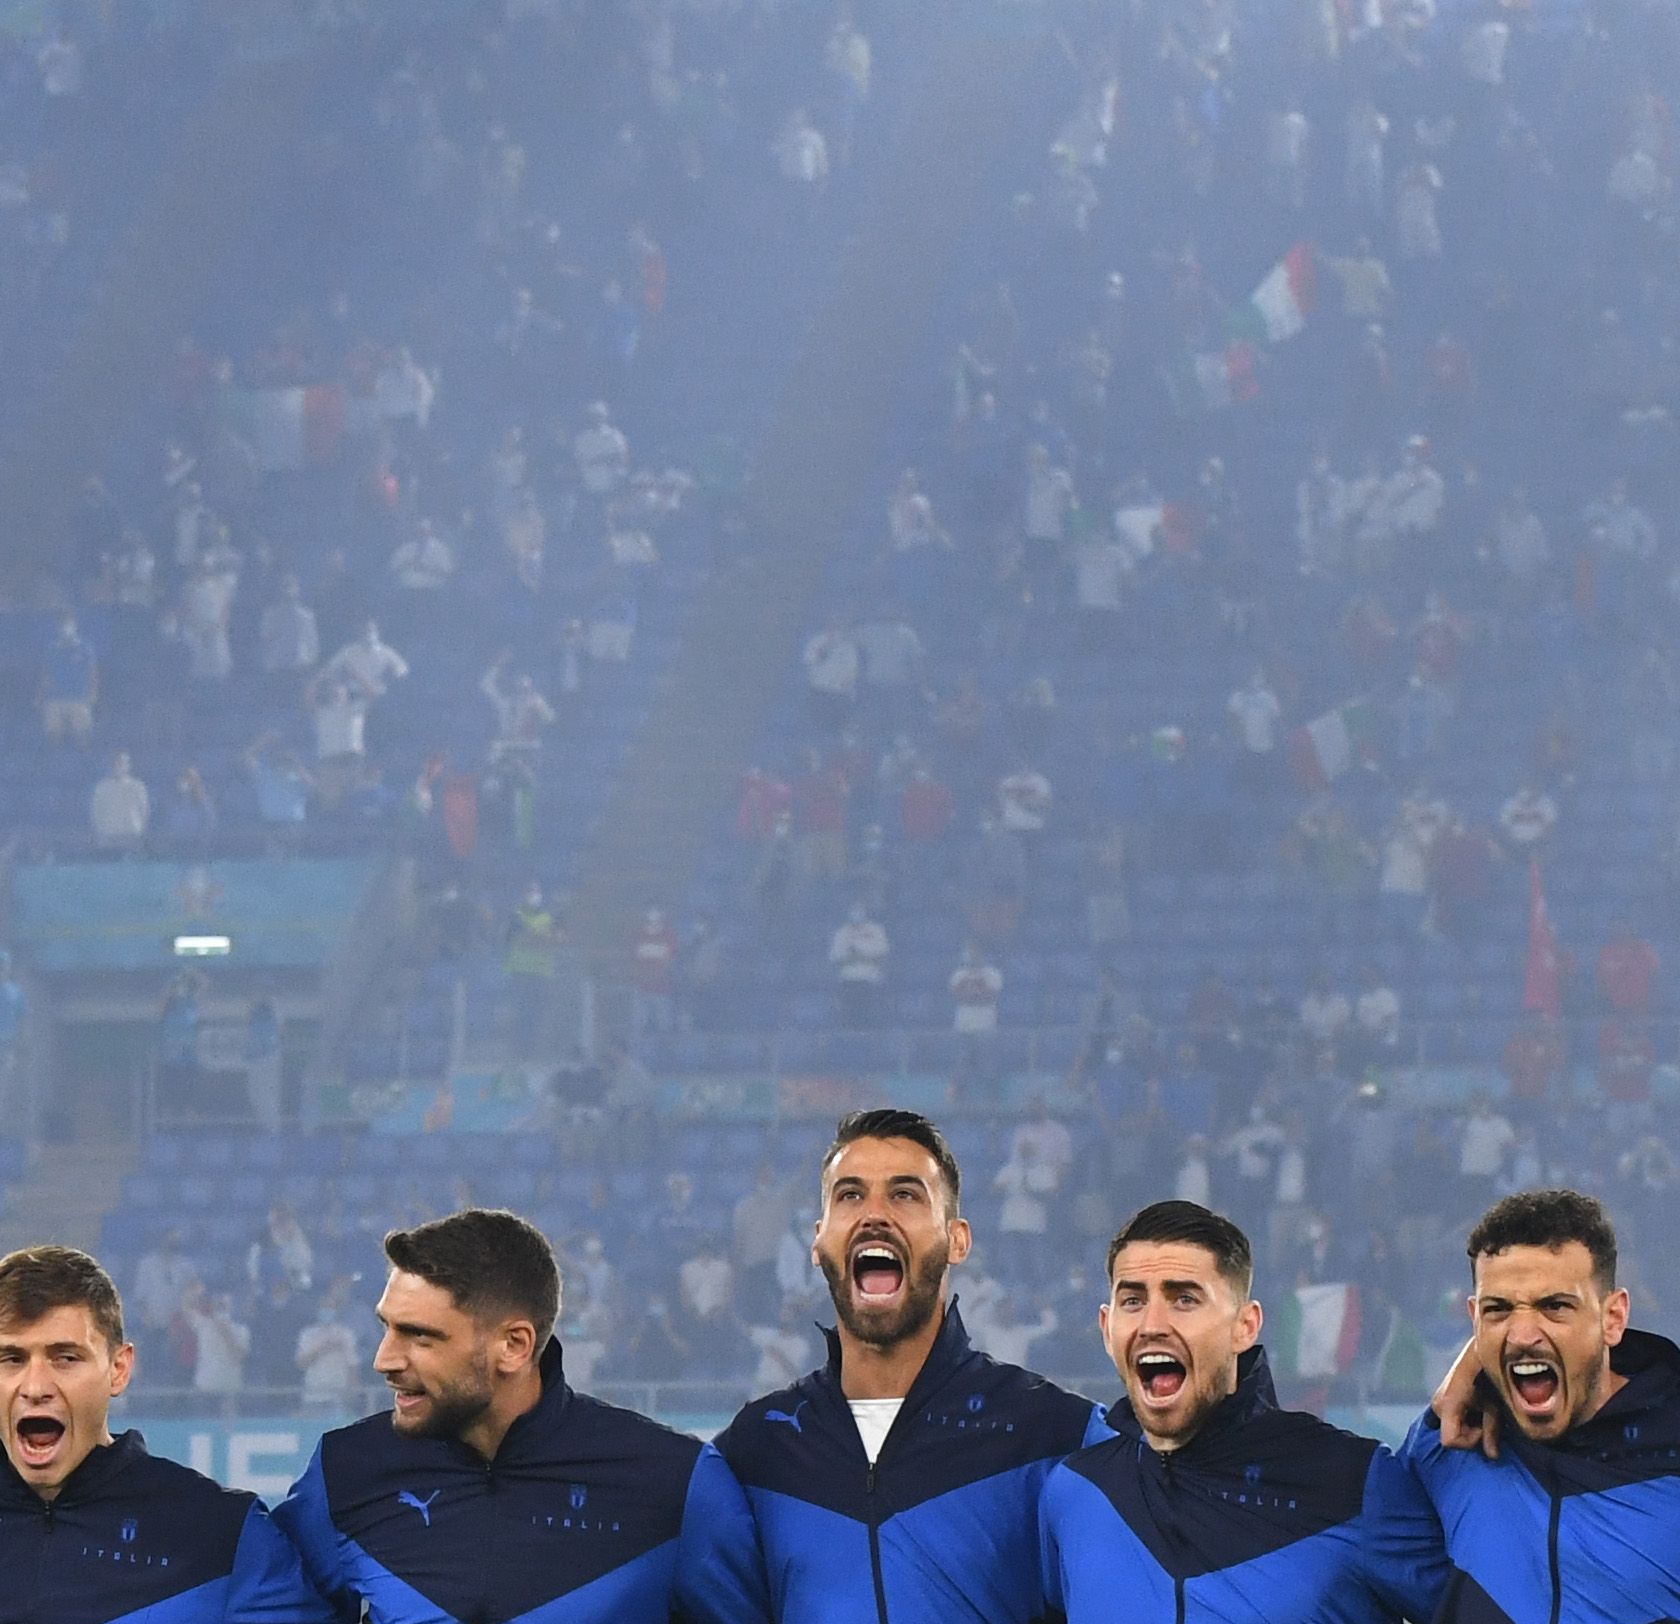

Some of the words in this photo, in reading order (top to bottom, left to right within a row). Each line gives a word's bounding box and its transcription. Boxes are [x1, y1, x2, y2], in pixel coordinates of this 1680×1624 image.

[1208, 1489, 1296, 1509] ITALIA
[531, 1515, 620, 1532] ITALIA
[82, 1547, 169, 1567] ITALIA
